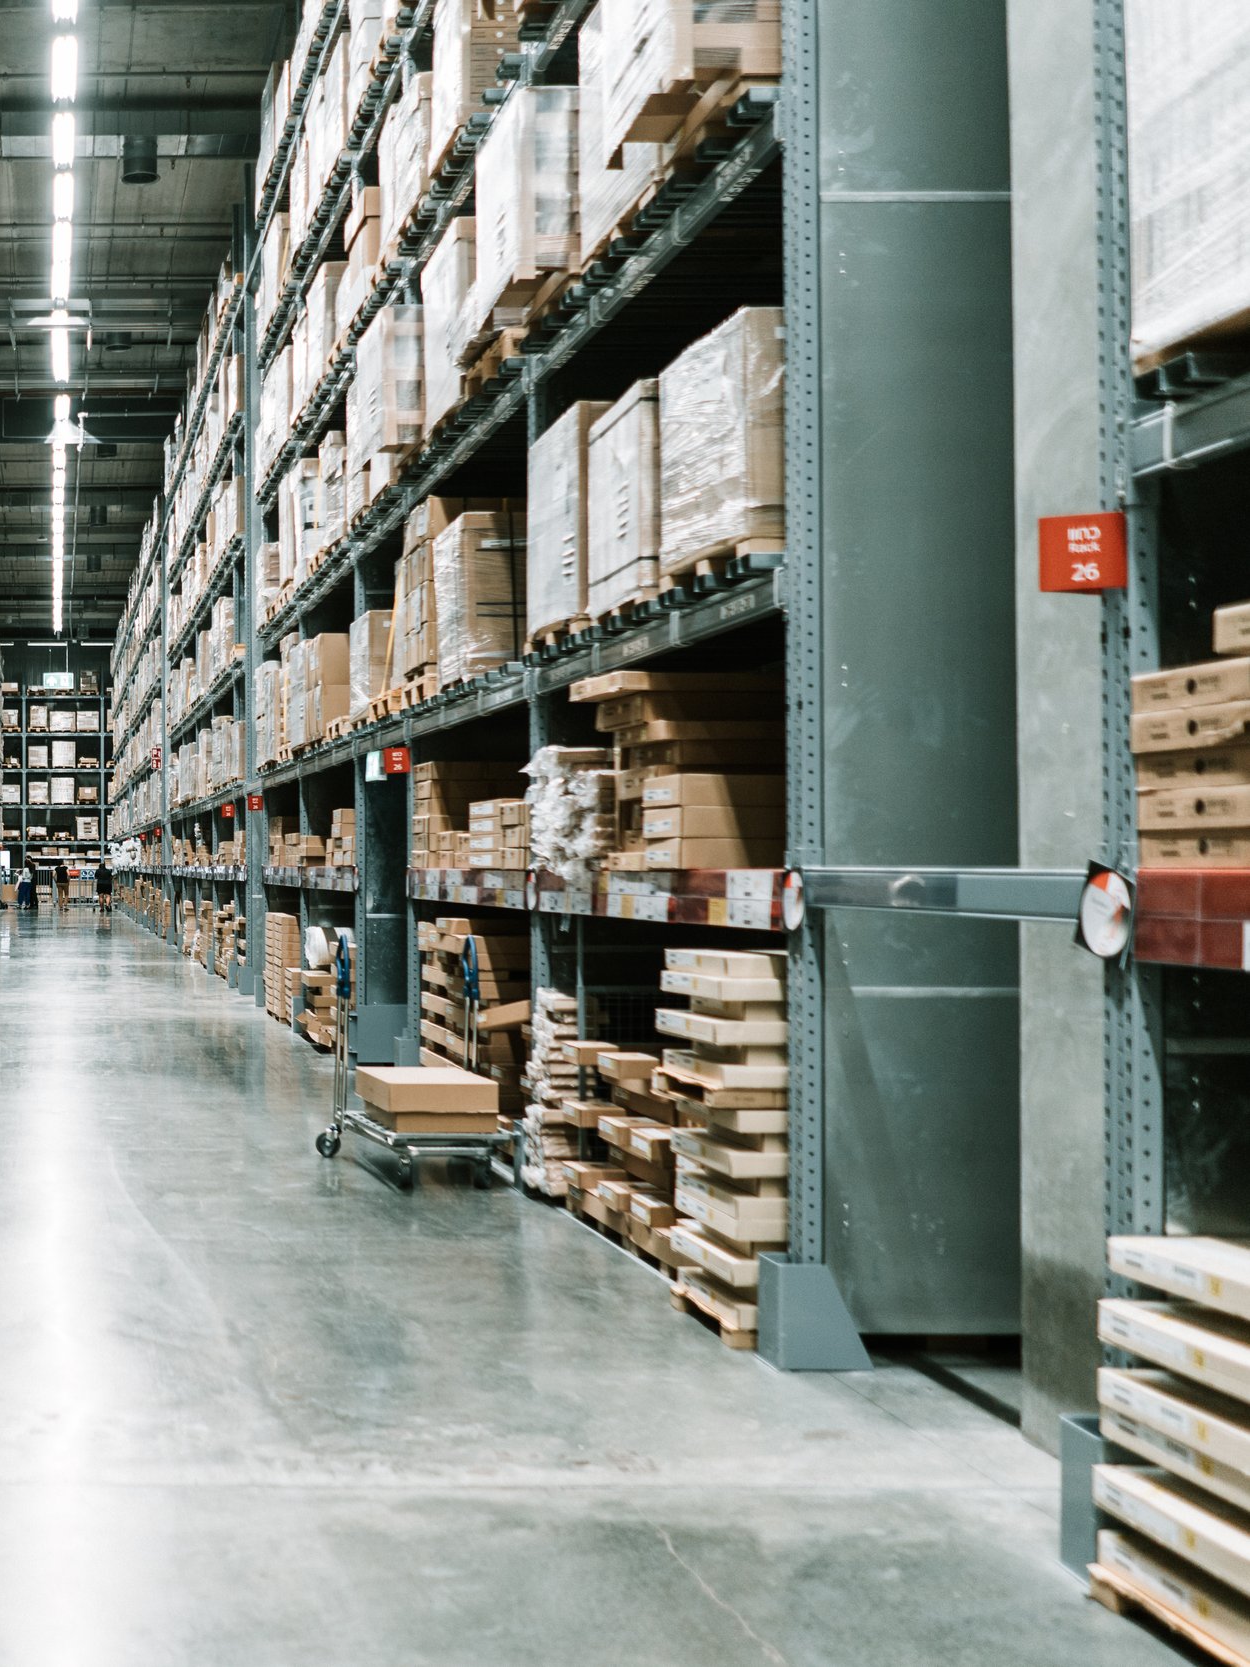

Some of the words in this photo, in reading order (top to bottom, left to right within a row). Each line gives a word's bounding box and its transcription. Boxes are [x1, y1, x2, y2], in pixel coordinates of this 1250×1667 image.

[1068, 541, 1101, 554] Rack
[1071, 562, 1100, 582] 26
[393, 763, 403, 771] 26
